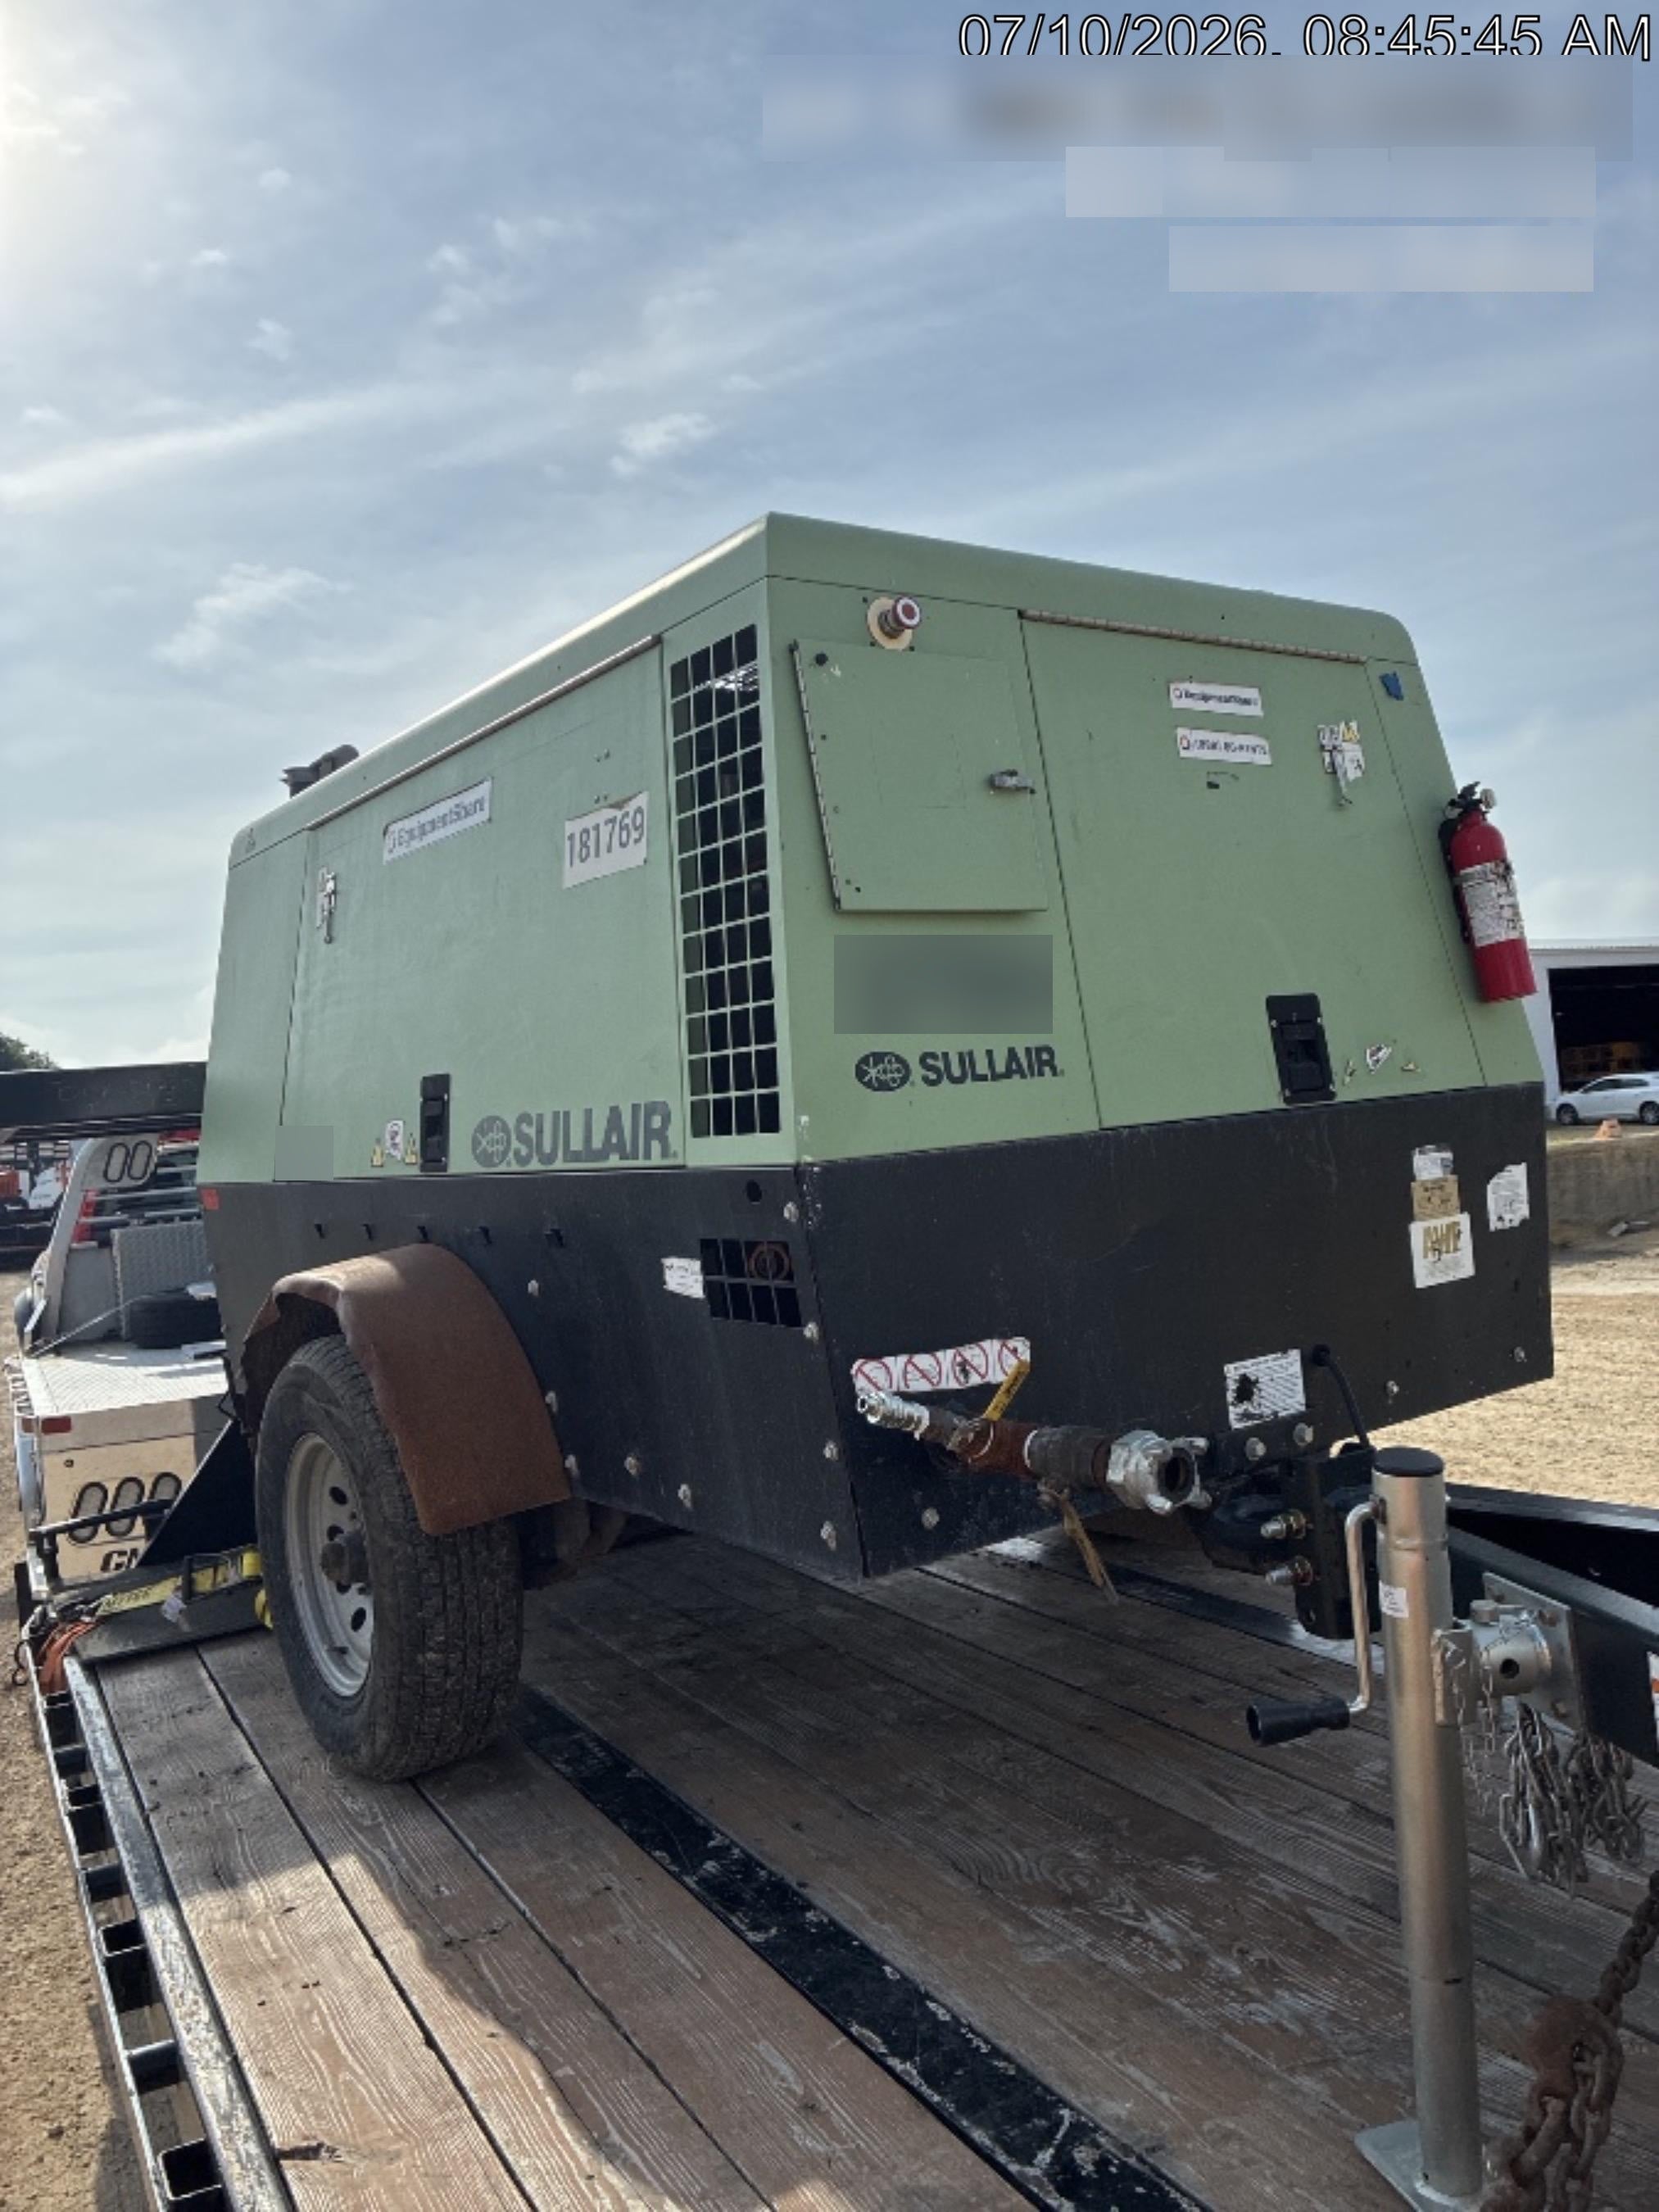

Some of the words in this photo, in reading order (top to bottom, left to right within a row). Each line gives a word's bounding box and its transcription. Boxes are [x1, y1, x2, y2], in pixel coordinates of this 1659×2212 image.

[566, 805, 645, 868] 181769
[918, 1044, 1058, 1087] SULLAIR
[514, 1100, 672, 1167] SULLAIR
